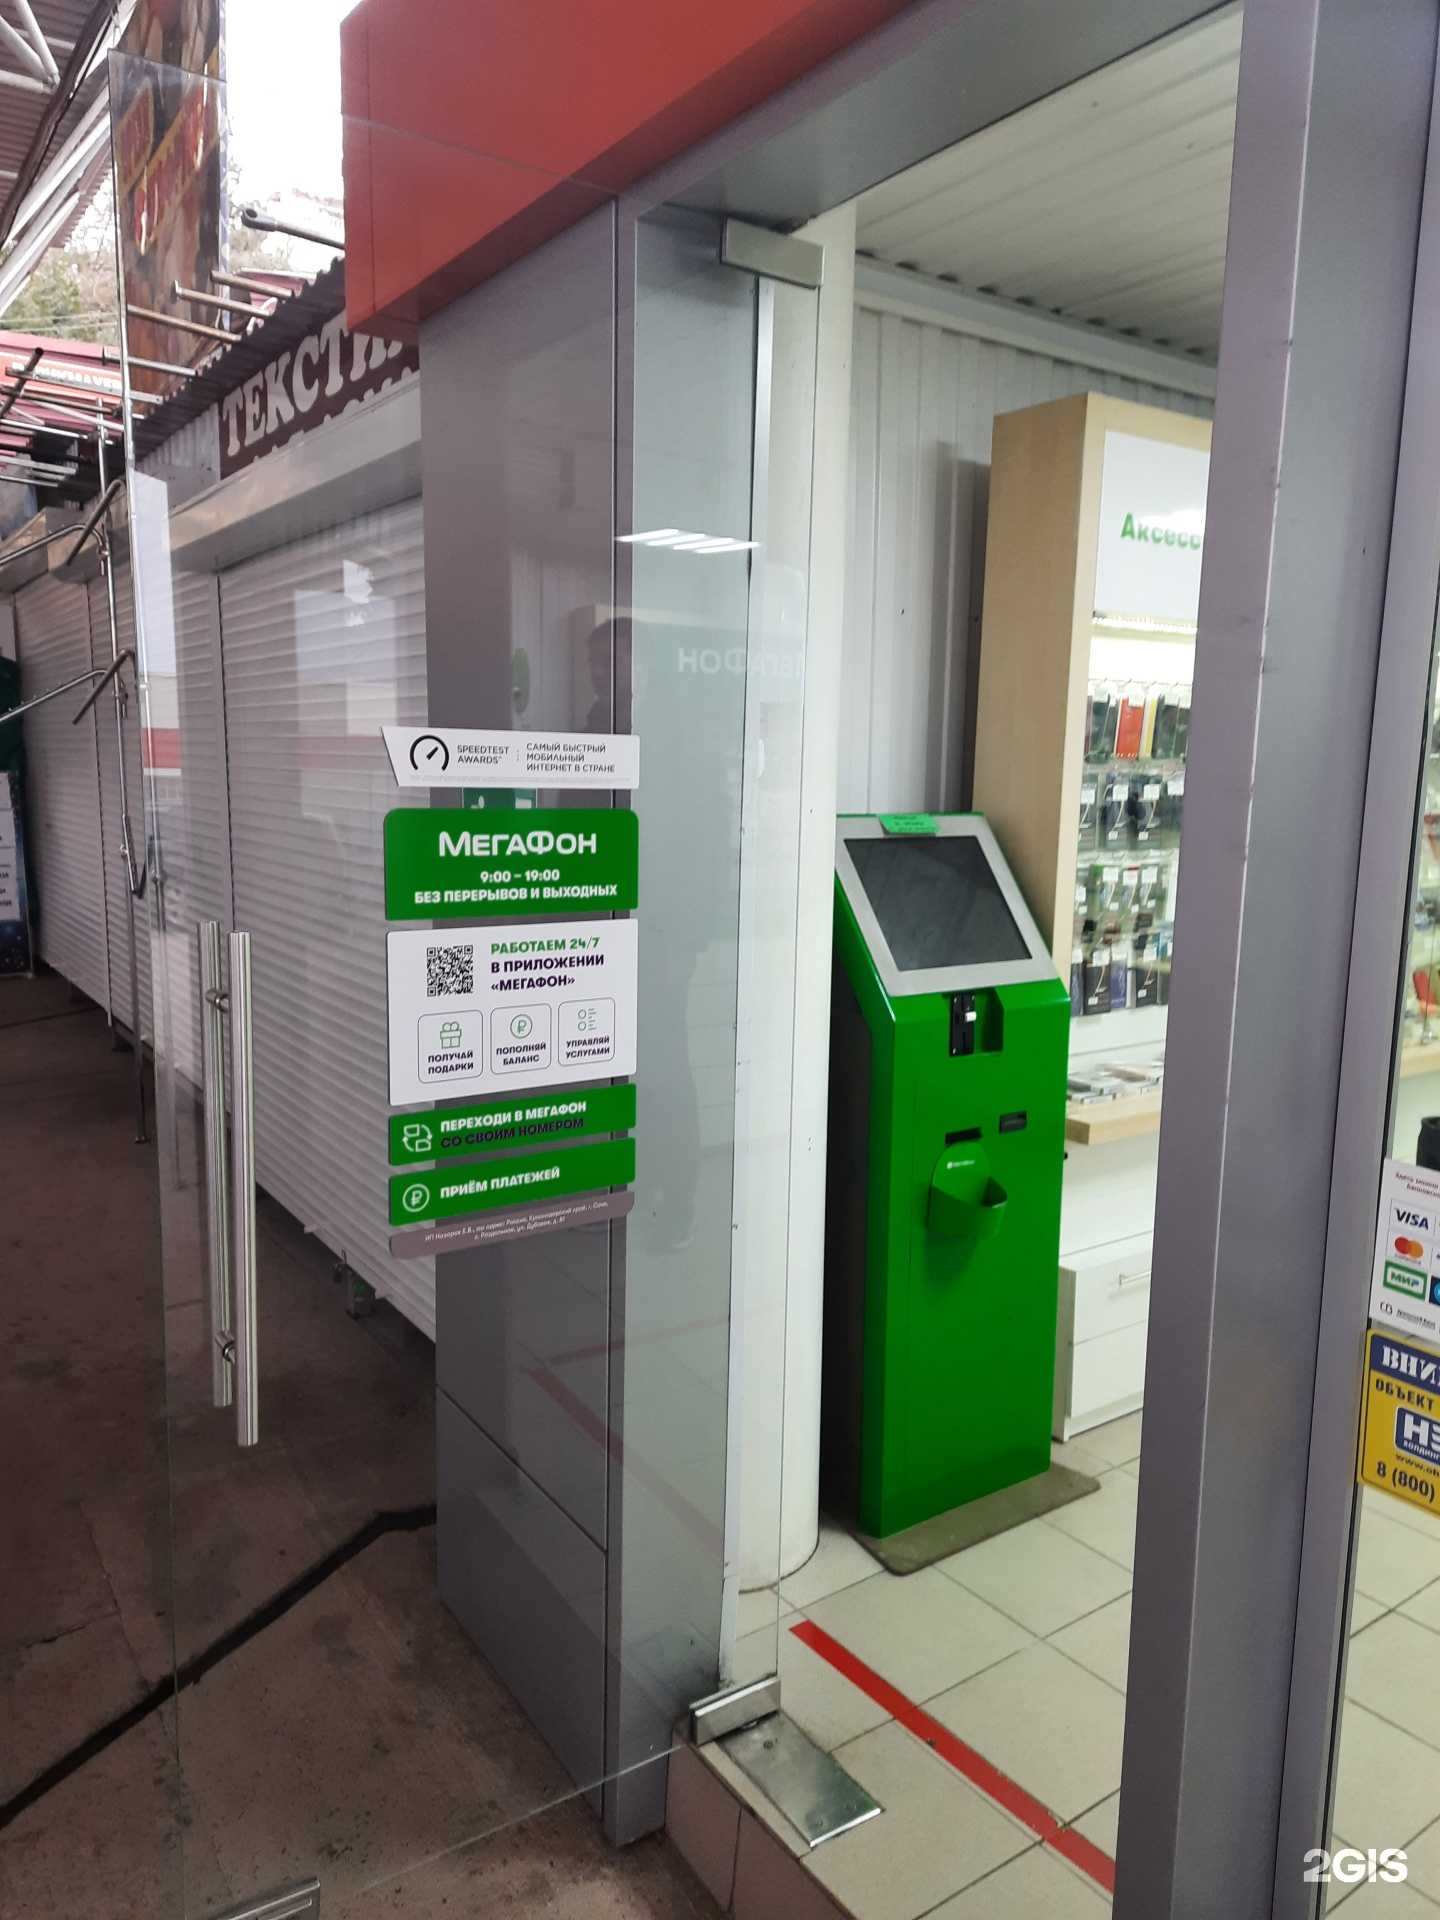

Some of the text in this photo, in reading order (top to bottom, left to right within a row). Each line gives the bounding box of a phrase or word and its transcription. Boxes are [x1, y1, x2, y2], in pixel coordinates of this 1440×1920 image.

[222, 308, 403, 456] ТЕКСТИ
[457, 744, 509, 755] SPEEDTEST
[526, 742, 606, 753] САМЫЙ БЫСТРЫЙ
[526, 752, 585, 763] МОБИЛЬНЫЙ
[526, 763, 615, 774] ИНТЕРНЕТ В СТРАНЕ
[480, 870, 512, 883] 9:00
[525, 869, 560, 882] 19:00
[414, 884, 617, 904] БЕЗ ПЕРЕРЫВОВ И ВЫХОДНЫХ
[491, 937, 601, 955] РАБОТАЕМ 24/7
[491, 954, 604, 974] В ПРИЛОЖЕНИИ
[491, 975, 575, 992] «МЕГАФОН»
[496, 1043, 546, 1056] ПОПОЛНЯЙ
[566, 1036, 610, 1048] УПРАВЛЯЙ
[428, 1051, 474, 1063] ПОЛУЧАЙ
[503, 1055, 540, 1066] БАЛАНС
[565, 1047, 610, 1059] УСЛУГАМИ
[428, 1063, 474, 1075] ПОДАРКИ
[440, 1101, 587, 1132] ПЕРЕХОДИ В МЕГАФОН
[440, 1118, 584, 1149] СО СВОИМ НОМЕРОМ
[440, 1167, 560, 1199] ПРИЁМ ПЛАТЕЖЕЙ
[1394, 1208, 1429, 1230] VISA
[1391, 1270, 1420, 1287] МИР
[1382, 1345, 1440, 1386] ВНИ
[1376, 1378, 1435, 1411] ОБЪЕКТ
[1376, 1461, 1436, 1502] 8 (800)
